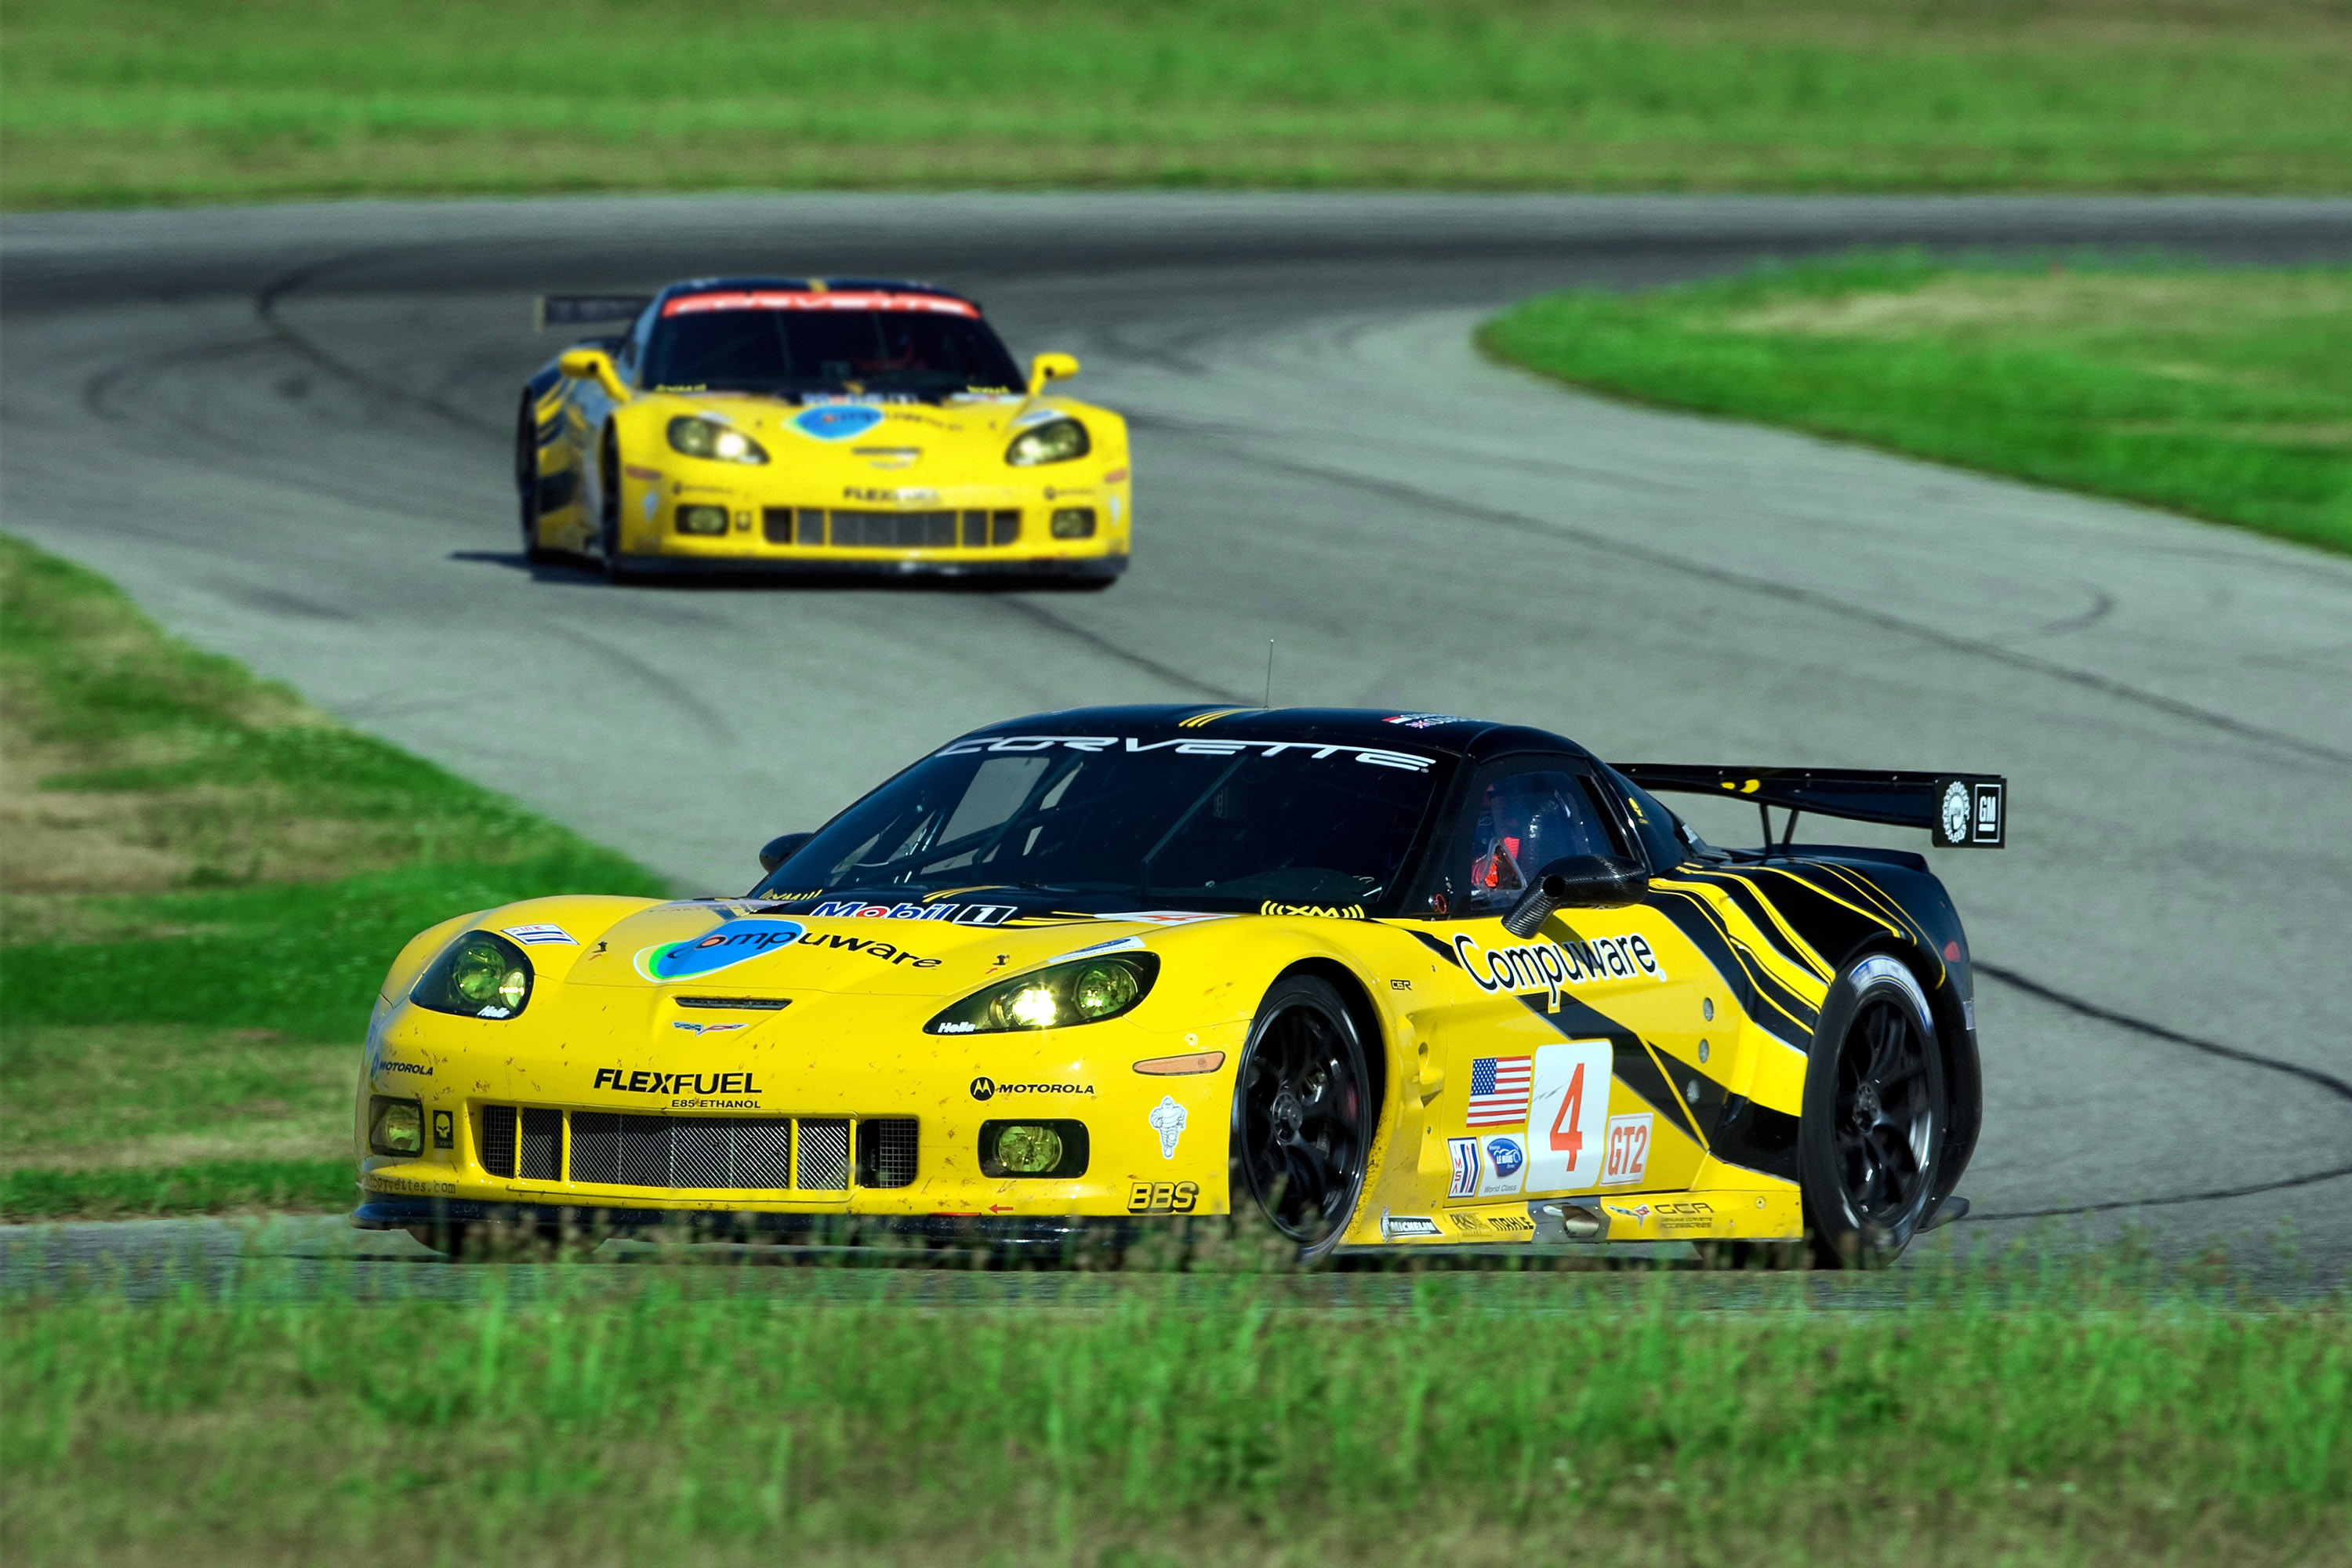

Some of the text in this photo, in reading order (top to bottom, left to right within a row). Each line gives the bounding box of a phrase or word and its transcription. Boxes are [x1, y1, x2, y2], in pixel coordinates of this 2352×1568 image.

[935, 735, 1436, 772] CORVETTE
[1979, 795, 1996, 822] GM
[809, 902, 960, 921] Mobil
[1453, 933, 1658, 1007] Compuware
[938, 1022, 976, 1033] Hella
[378, 1061, 434, 1076] MOTOROLA
[593, 1068, 762, 1094] FLEXFUEL
[999, 1083, 1094, 1094] MOTOROLA
[672, 1099, 761, 1109] E85 ETHANOL
[1550, 1063, 1585, 1172] 4
[1608, 1125, 1647, 1176] GT2
[1127, 1181, 1200, 1214] BBS
[1654, 1202, 1715, 1214] GCA
[1390, 1221, 1437, 1232] MICHELIN
[1487, 1216, 1534, 1232] MAHLE
